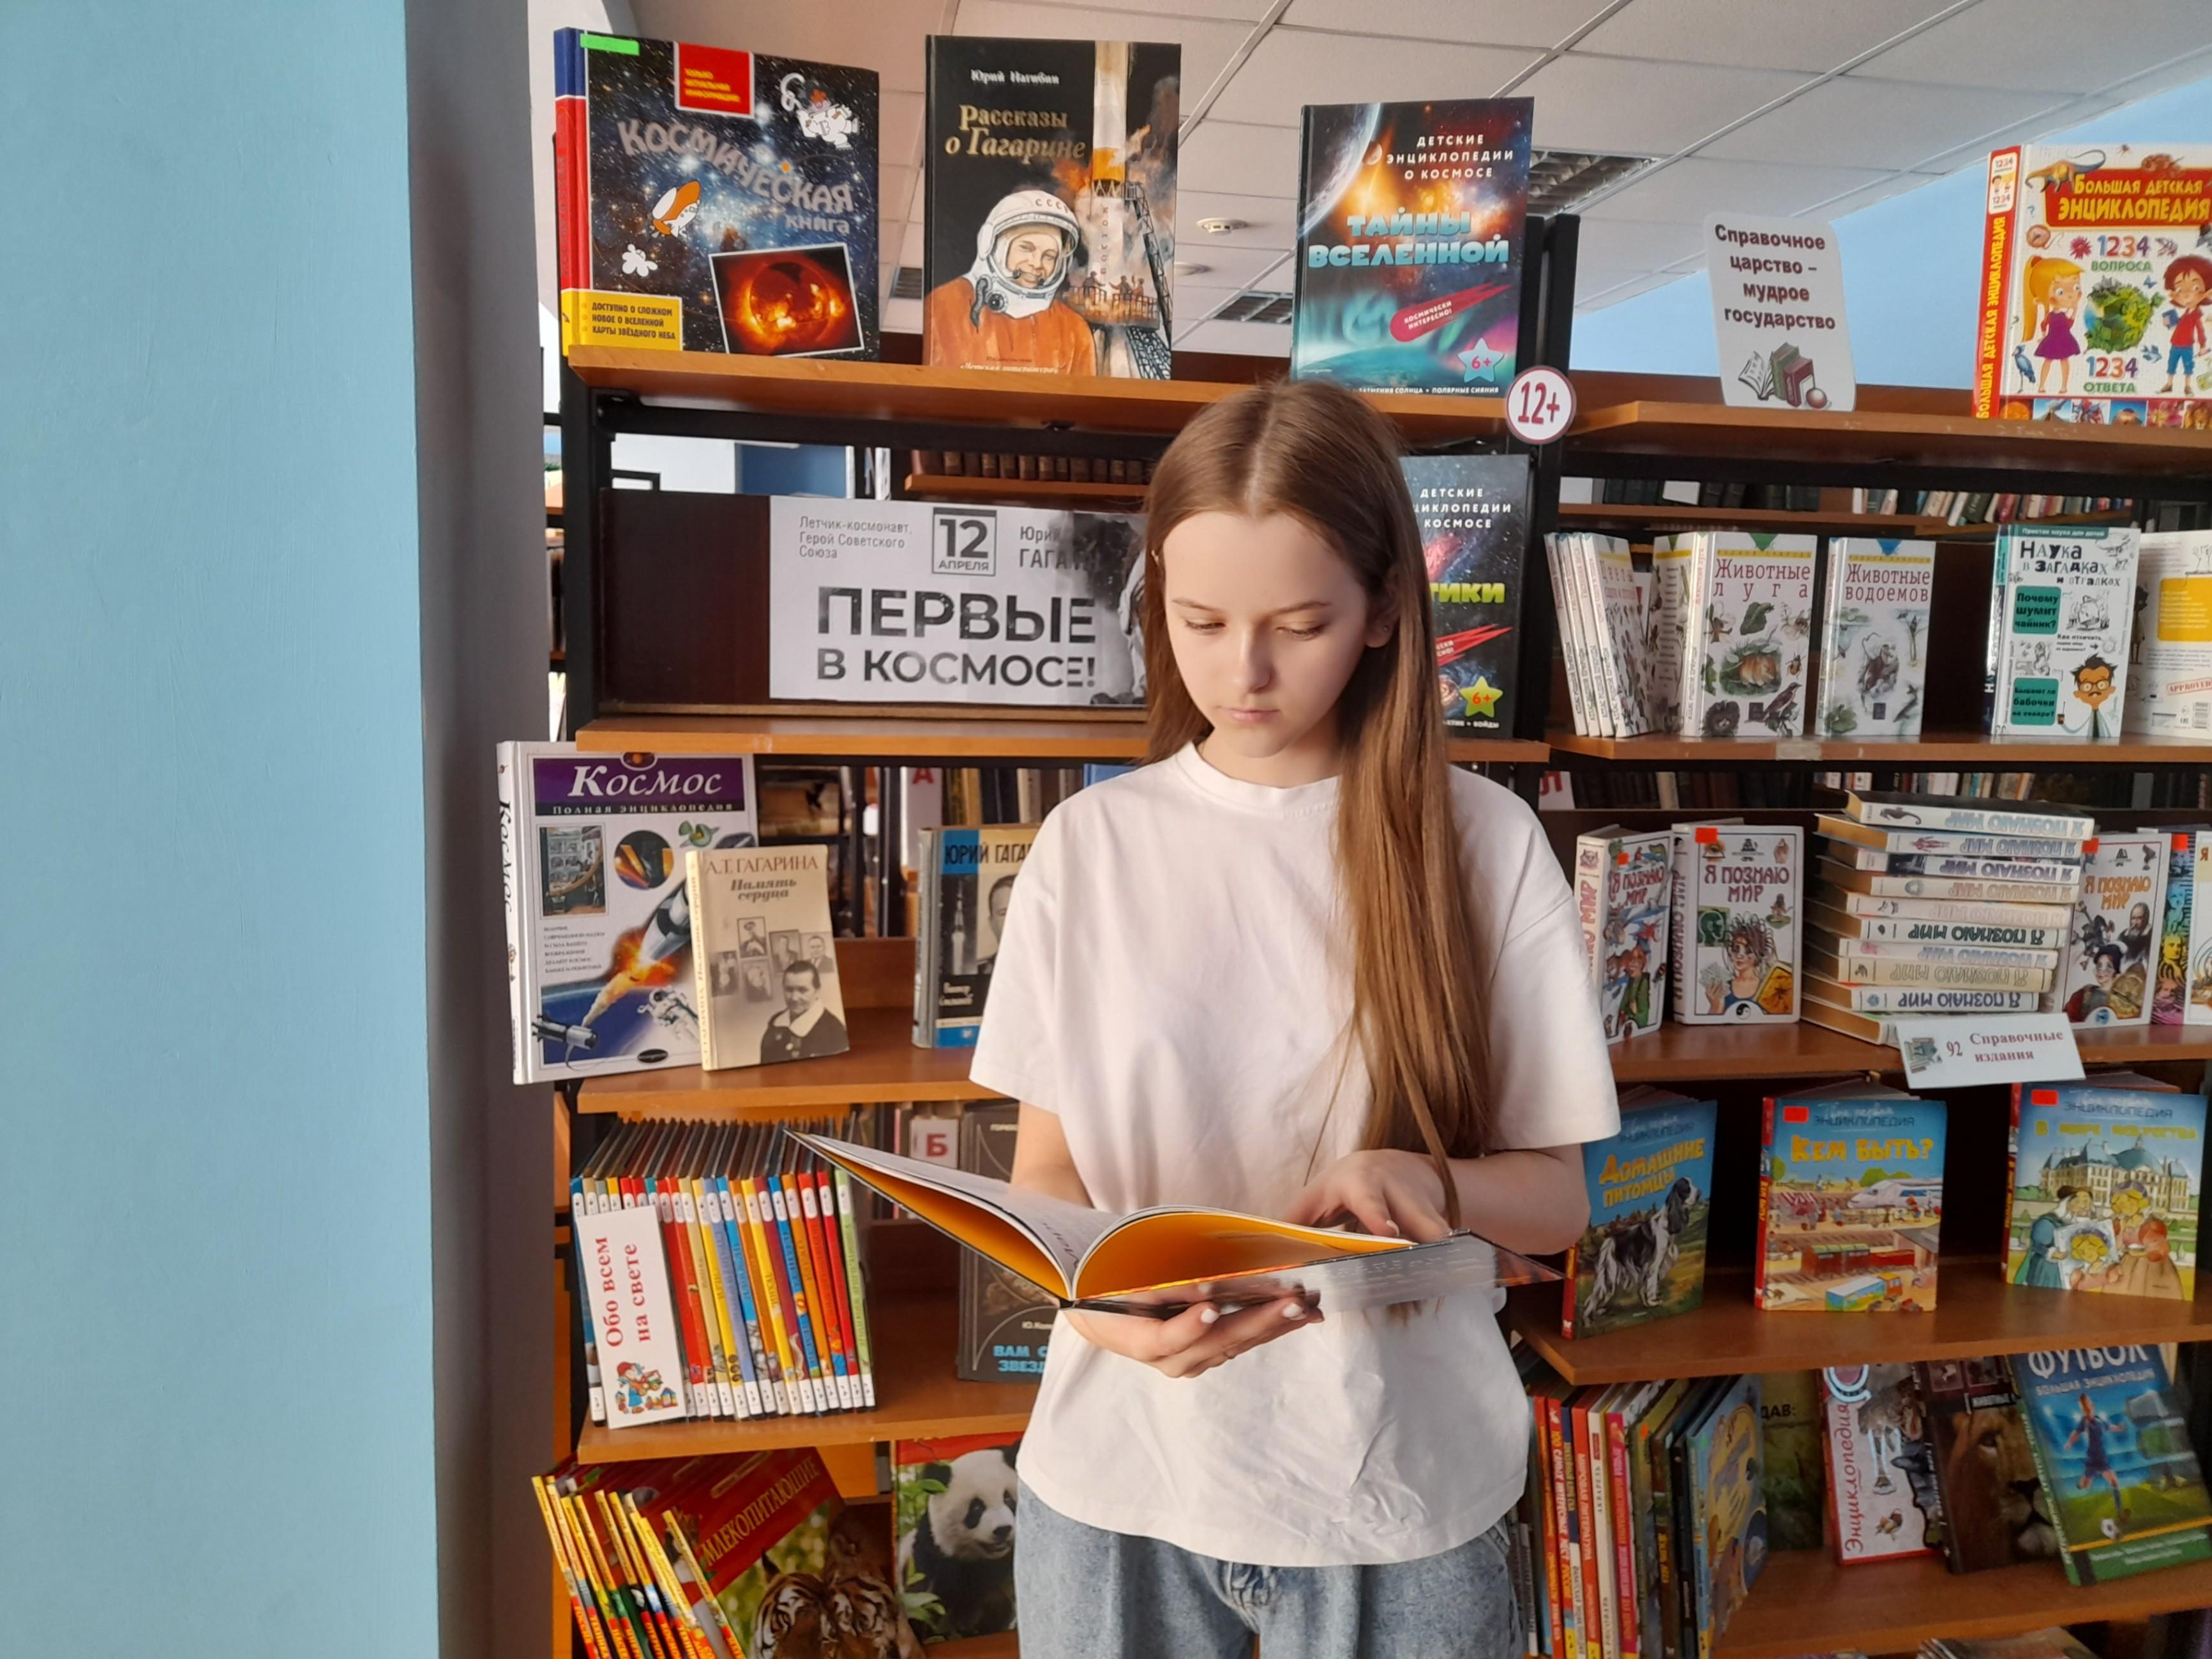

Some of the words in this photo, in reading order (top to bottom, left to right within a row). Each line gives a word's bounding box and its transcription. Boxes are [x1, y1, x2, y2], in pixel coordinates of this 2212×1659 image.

[970, 69, 1005, 84] Юрий
[1010, 71, 1060, 84] Нагибин
[959, 104, 1069, 131] Рассказы
[945, 136, 961, 154] о
[967, 127, 1087, 165] Гагарине
[1417, 134, 1484, 147] ДЕТСКИЕ
[617, 117, 854, 213] КОСМИЧЕСКАЯ
[1387, 150, 1514, 165] ЭНЦИКЛОПЕДИИ
[1404, 170, 1414, 180] О
[1421, 167, 1493, 180] КОСМОСЕ
[2074, 174, 2142, 194] БОЛЬШАЯ
[2146, 177, 2203, 195] ДЕТСКАЯ
[2058, 198, 2211, 222] ЭНЦИКЛОПЕДИЯ
[1347, 207, 1471, 237] ТАЙНЫ
[1714, 224, 1826, 250] Справочное
[2097, 235, 2150, 256] 1234
[1307, 234, 1510, 268] ВСЕЛЕННОЙ
[1730, 255, 1803, 274] царство
[1987, 216, 2006, 307] ЭНЦИКЛОПЕДИЯ
[2091, 260, 2153, 273] ВОПРОСА
[1743, 283, 1810, 304] мудрое
[592, 302, 628, 312] ДОСТУПНО
[638, 306, 673, 317] СЛОЖНОМ
[1404, 301, 1452, 324] КОСМИЧЕСКИ
[592, 314, 615, 323] НОВОЕ
[624, 317, 664, 327] ВСЕЛЕННОЙ
[1408, 308, 1453, 330] ИНТЕРЕСНО!
[1724, 308, 1836, 330] государство
[592, 326, 616, 334] КАРТЫ
[1983, 309, 1998, 359] ДЕТСКАЯ
[1471, 355, 1492, 370] 6+
[2086, 357, 2138, 378] 1234
[1976, 363, 1993, 419] БОЛЬШАЯ
[2083, 382, 2136, 393] ОТВЕТА
[1517, 380, 1560, 425] 12+
[1419, 488, 1484, 499] ДЕТСКИЕ
[1424, 518, 1493, 529] КОСМОСЕ
[799, 532, 834, 546] Герой
[838, 534, 905, 549] Советского
[939, 518, 989, 559] 12
[799, 546, 838, 559] Союза
[938, 560, 989, 572] АПРЕЛЯ
[1713, 559, 1811, 580] Животные
[1846, 564, 1931, 585] Животные
[1846, 585, 1929, 604] водоемов
[2017, 593, 2059, 604] Почему
[818, 586, 1097, 645] ПЕРВЫЕ
[2016, 607, 2057, 617] шумит
[2015, 620, 2056, 629] чайник?
[816, 648, 847, 680] В
[863, 649, 1096, 688] КОСМОСЕ!
[1471, 692, 1492, 705] 6+
[568, 765, 722, 797] Космос
[1945, 811, 1986, 828] МИР
[1988, 814, 2066, 836] ПОЗНАЮ
[2068, 822, 2086, 837] Я
[1960, 837, 1994, 849] МИР
[1996, 839, 2063, 855] ПОЗНАЮ
[2065, 843, 2077, 855] Я
[945, 843, 989, 864] ЮРИЙ
[2200, 847, 2209, 862] Я
[737, 856, 818, 874] ГАГАРИНА
[1939, 860, 1978, 876] МИР
[1978, 863, 2055, 879] ПОЗНАЮ
[1704, 866, 1717, 884] Я
[1721, 865, 1790, 884] ПОЗНАЮ
[2057, 869, 2073, 882] Я
[731, 878, 797, 891] Память
[2084, 875, 2095, 894] Я
[2097, 875, 2152, 893] ПОЗНАЮ
[738, 889, 790, 903] сердца
[1727, 885, 1764, 903] МИР
[2100, 892, 2131, 910] МИР
[1907, 923, 1948, 940] МИР
[1952, 926, 2026, 943] ПОЗНАЮ
[2030, 929, 2045, 945] Я
[1890, 963, 1929, 980] МИР
[1934, 966, 2010, 985] ПОЗНАЮ
[2014, 970, 2029, 987] Я
[1898, 991, 1934, 1007] МИР
[1937, 991, 2005, 1007] ПОЗНАЮ
[2008, 992, 2022, 1008] Я
[1946, 1041, 1964, 1057] 92
[1969, 1031, 2065, 1049] Справочные
[1975, 1050, 2035, 1063] издания
[926, 1134, 949, 1157] Б
[1791, 1134, 1847, 1162] КЕМ
[1856, 1137, 1934, 1162] БЫТЬ?
[1599, 1137, 1706, 1184] ДОМАШНИЕ
[1603, 1167, 1676, 1208] ПИТОМЦЫ
[595, 1236, 616, 1294] всем
[624, 1243, 644, 1307] свете
[602, 1299, 624, 1347] Обо
[635, 1314, 652, 1342] на
[993, 1346, 1030, 1358] ВАМ
[2028, 1346, 2149, 1379] ФУТБОЛ
[1760, 1404, 1796, 1420] ДАВ:
[1836, 1404, 1864, 1552] Энциклопедия
[704, 1457, 822, 1568] МЛЕКОПИТАЮЩИЕ
